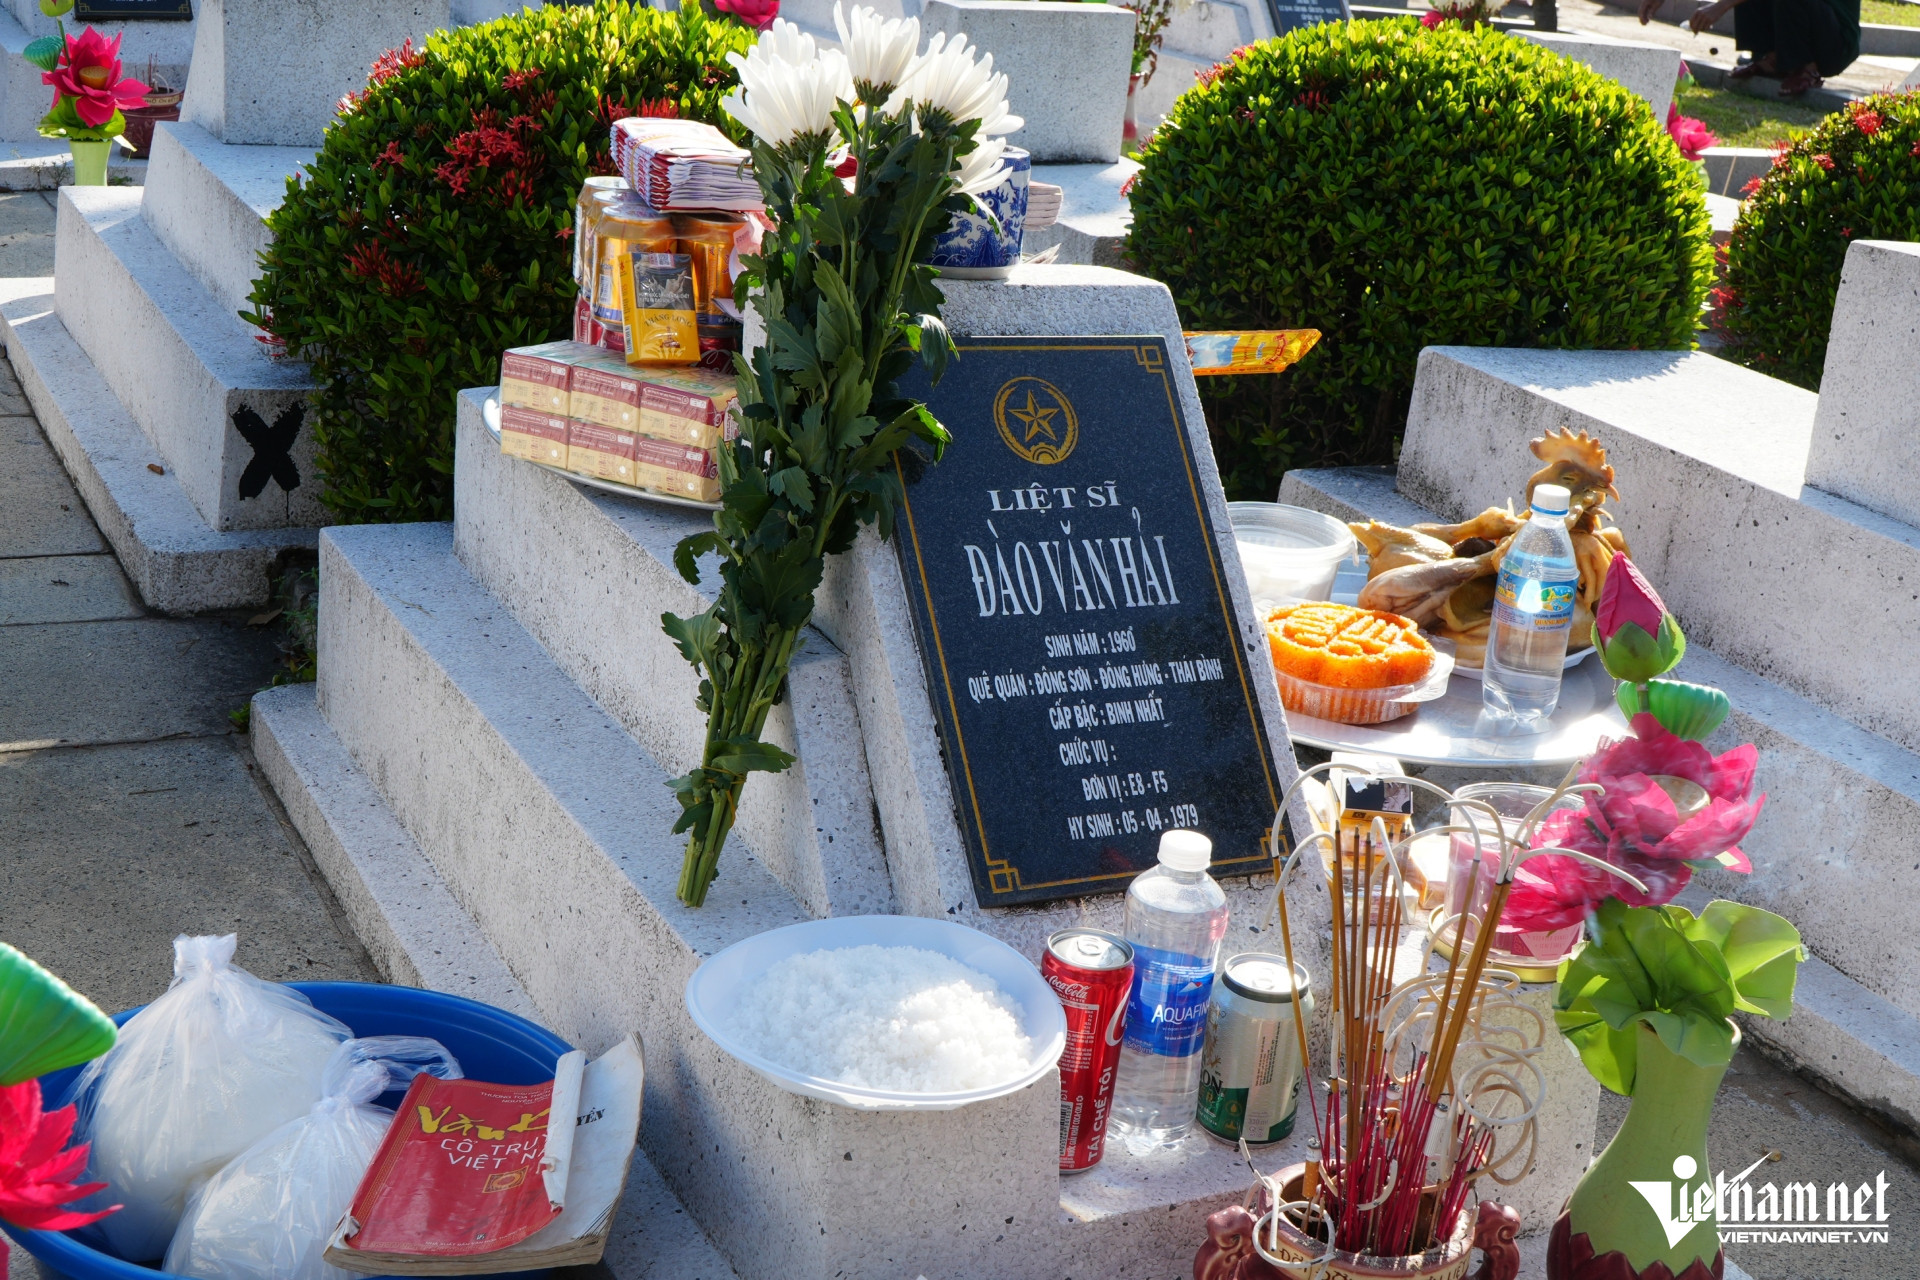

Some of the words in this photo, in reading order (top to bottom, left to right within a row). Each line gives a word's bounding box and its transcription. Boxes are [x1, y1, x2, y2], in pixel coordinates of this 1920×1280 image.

[987, 481, 1077, 515] LIỆT
[1086, 480, 1122, 509] SĨ
[963, 518, 1043, 618] ĐÀO
[1038, 519, 1119, 614] VĂN
[1110, 506, 1181, 608] HẢI
[1044, 634, 1073, 658] SINH
[1072, 628, 1101, 656] NĂM
[1107, 629, 1136, 654] 1960
[967, 669, 994, 704] QUÊ
[994, 667, 1028, 702] QUÁN
[1034, 665, 1068, 695] ĐÔNG
[1067, 665, 1093, 692] SƠN
[1098, 660, 1132, 690] ĐÔNG
[1131, 660, 1164, 687] HƯNG
[1168, 654, 1197, 684] THÁI
[1195, 653, 1225, 682] BÌNH
[1049, 697, 1073, 731] CẤP
[1073, 698, 1099, 732] BẬC
[1105, 700, 1135, 726] BINH
[1134, 689, 1165, 723] NHẤT
[1058, 735, 1092, 767] CHỨC
[1091, 739, 1109, 767] VỤ
[1081, 773, 1108, 802] ĐƠN
[1107, 775, 1123, 804] VỊ
[1127, 772, 1146, 796] E8
[1151, 770, 1169, 794] F5
[1067, 816, 1085, 841] HY
[1086, 812, 1115, 839] SINH
[1121, 809, 1138, 835] 05
[1145, 807, 1163, 832] 04
[1169, 803, 1199, 829] 1979
[1048, 975, 1092, 999] Coca-Cola
[1098, 1065, 1113, 1096] TÔI
[1093, 1096, 1108, 1132] CHẾ
[440, 1138, 479, 1154] CỔ
[448, 1153, 507, 1171] VIỆT
[1087, 1134, 1101, 1162] TÁI
